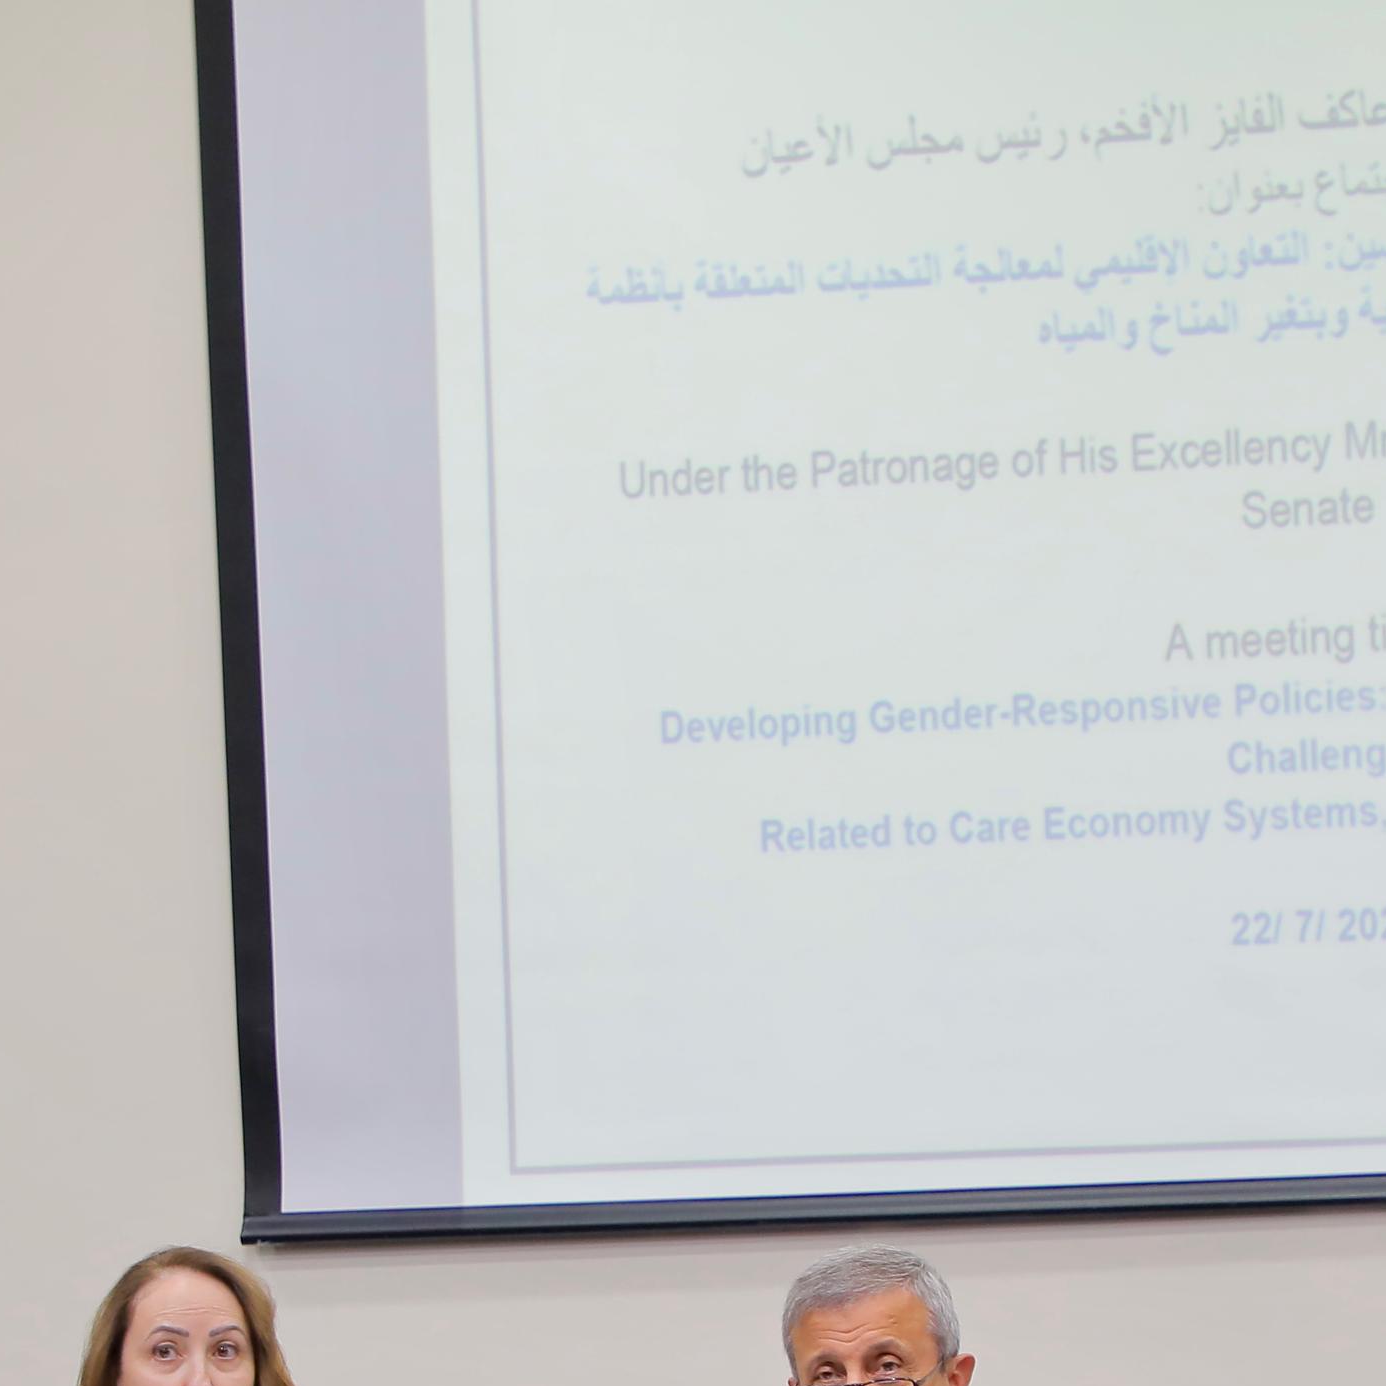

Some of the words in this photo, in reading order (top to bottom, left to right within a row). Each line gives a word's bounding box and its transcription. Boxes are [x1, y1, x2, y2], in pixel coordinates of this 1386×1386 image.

[866, 114, 965, 171] مجلس
[816, 251, 942, 301] التحديات
[952, 243, 1065, 294] لمعالجة
[1203, 230, 1307, 280] التعاون
[1038, 306, 1139, 352] والمياه
[1148, 299, 1238, 356] المناخ
[619, 457, 732, 499] Under
[740, 453, 798, 493] the
[810, 448, 999, 492] Patronage
[1011, 437, 1049, 478] of
[1059, 436, 1119, 474] His
[1131, 427, 1332, 472] Excellency
[1242, 487, 1376, 530] Senate
[1165, 622, 1194, 661] A
[1205, 619, 1355, 663] meeting
[659, 704, 858, 747] Developing
[867, 689, 1221, 734] Gender-Responsive
[1235, 682, 1386, 717] Policies:
[759, 813, 892, 853] Related
[902, 814, 938, 846] to
[948, 809, 1031, 844] Care
[1043, 805, 1212, 843] Economy
